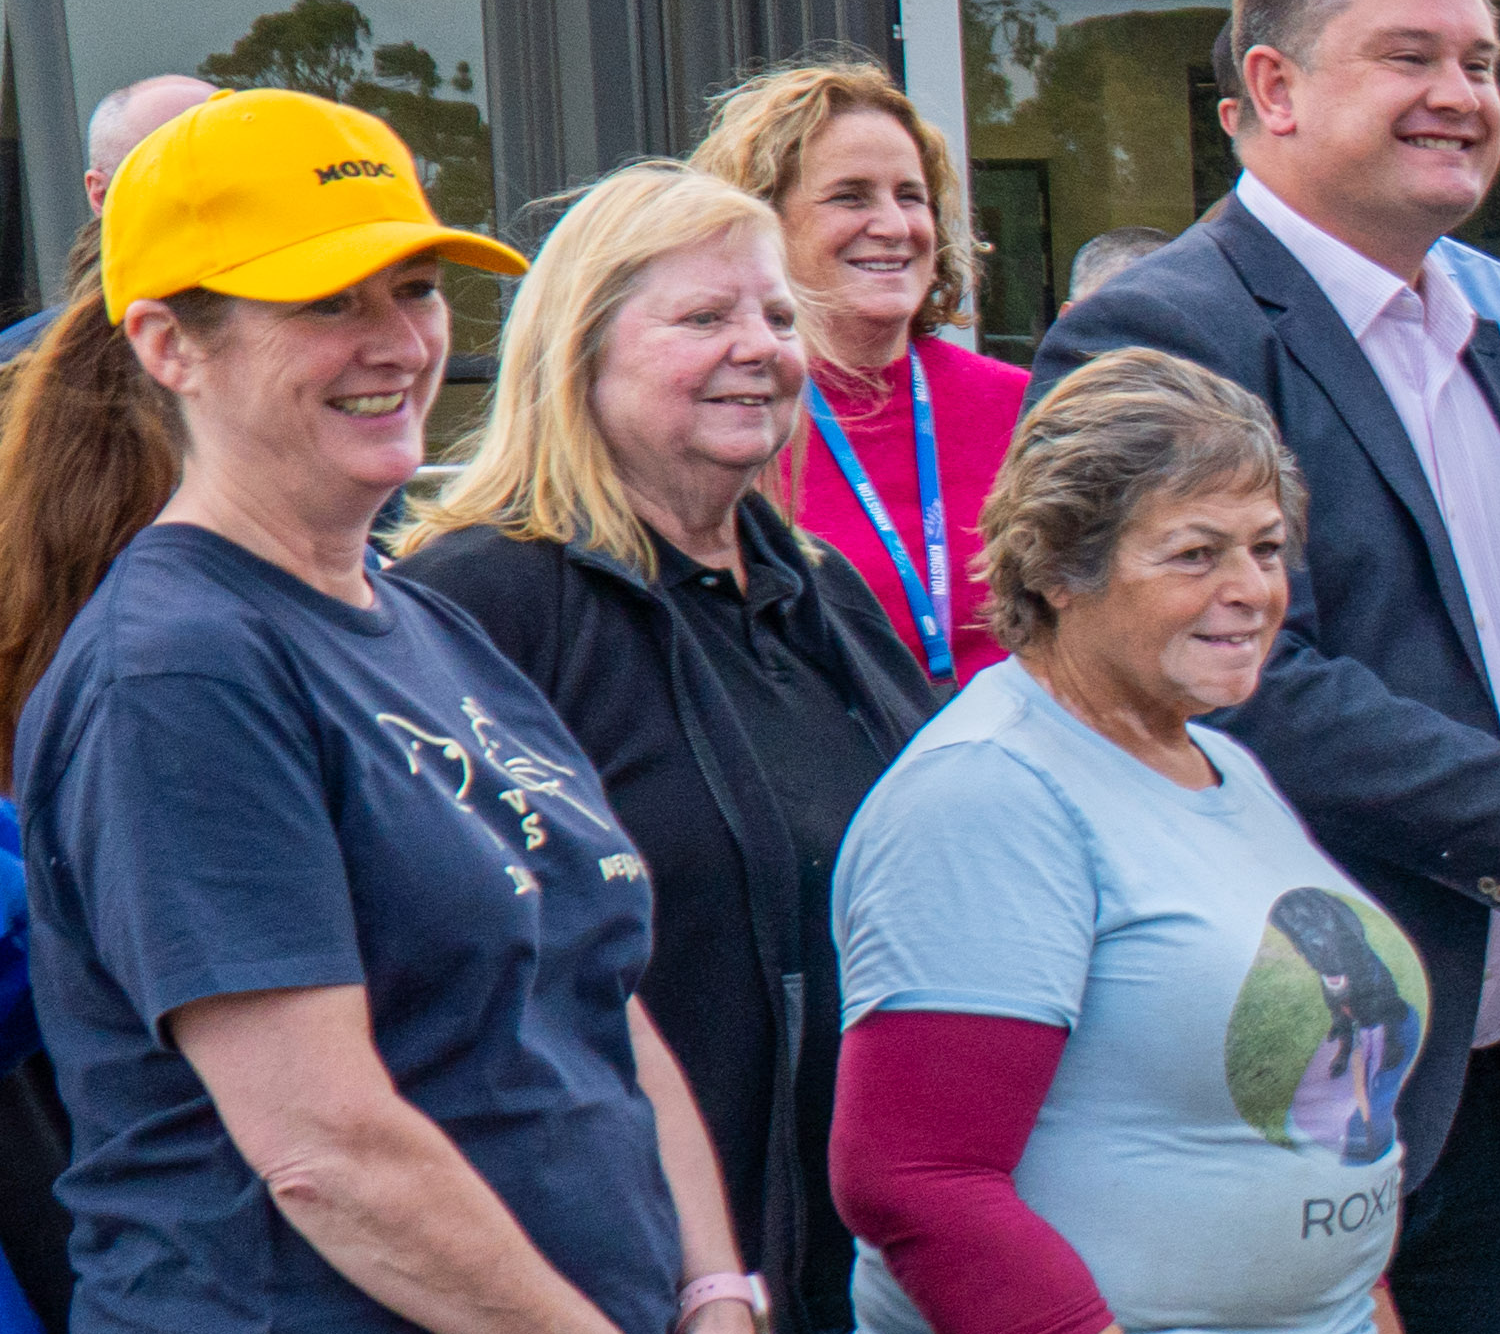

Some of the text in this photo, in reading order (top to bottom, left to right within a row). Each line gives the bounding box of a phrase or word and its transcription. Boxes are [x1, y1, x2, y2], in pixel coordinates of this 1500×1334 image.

[313, 160, 395, 186] MODC
[855, 482, 892, 532] KINGSTON
[928, 544, 947, 596] KINGSTON
[1302, 1175, 1398, 1240] ROXI
